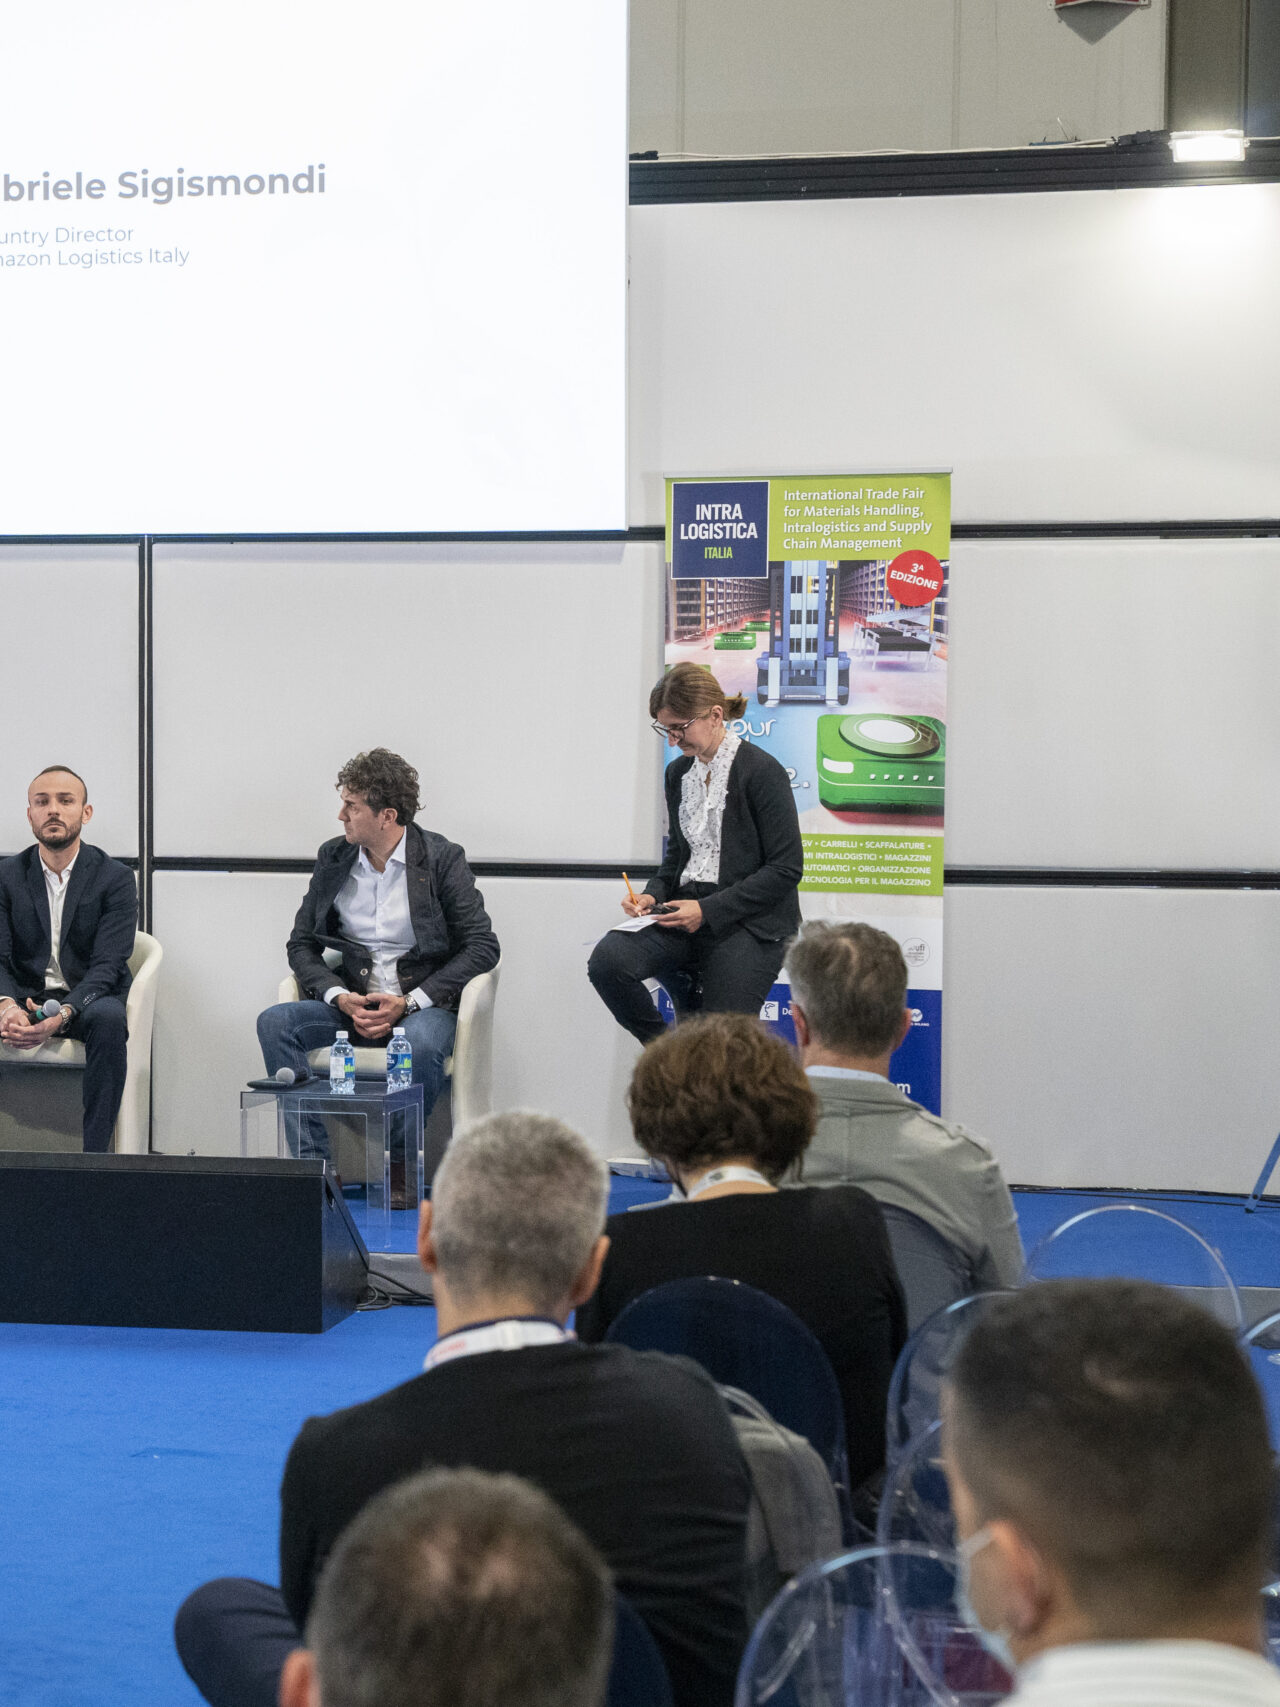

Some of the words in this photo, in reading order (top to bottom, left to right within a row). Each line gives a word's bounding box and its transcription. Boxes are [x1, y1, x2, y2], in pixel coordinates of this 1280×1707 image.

[117, 164, 327, 206] Sigismondi
[55, 224, 134, 245] Director
[57, 247, 143, 270] Logistics
[149, 246, 190, 268] Italy
[784, 489, 863, 501] International
[865, 488, 899, 500] Trade
[902, 487, 925, 499] Fair
[696, 503, 743, 521] INTRA
[784, 506, 801, 518] for
[804, 505, 861, 518] Materials
[864, 504, 924, 521] Handling,
[680, 522, 758, 540] LOGISTICA
[783, 521, 860, 537] Intralogistics
[863, 520, 886, 533] and
[888, 520, 933, 535] Supply
[783, 537, 818, 550] Chain
[820, 536, 903, 552] Management
[704, 546, 733, 560] ITALIA
[890, 569, 939, 591] EDIZIONE
[726, 718, 777, 737] our
[820, 840, 858, 848] CARRELLI
[865, 841, 925, 850] SCAFFALATURE
[816, 852, 877, 861] INTRALOGISTICI
[884, 854, 932, 862] MAGAZZINI
[857, 865, 931, 874] ORGANIZZAZIONE
[855, 877, 870, 885] PER
[872, 877, 878, 885] IL
[880, 878, 931, 887] MAGAZZINO
